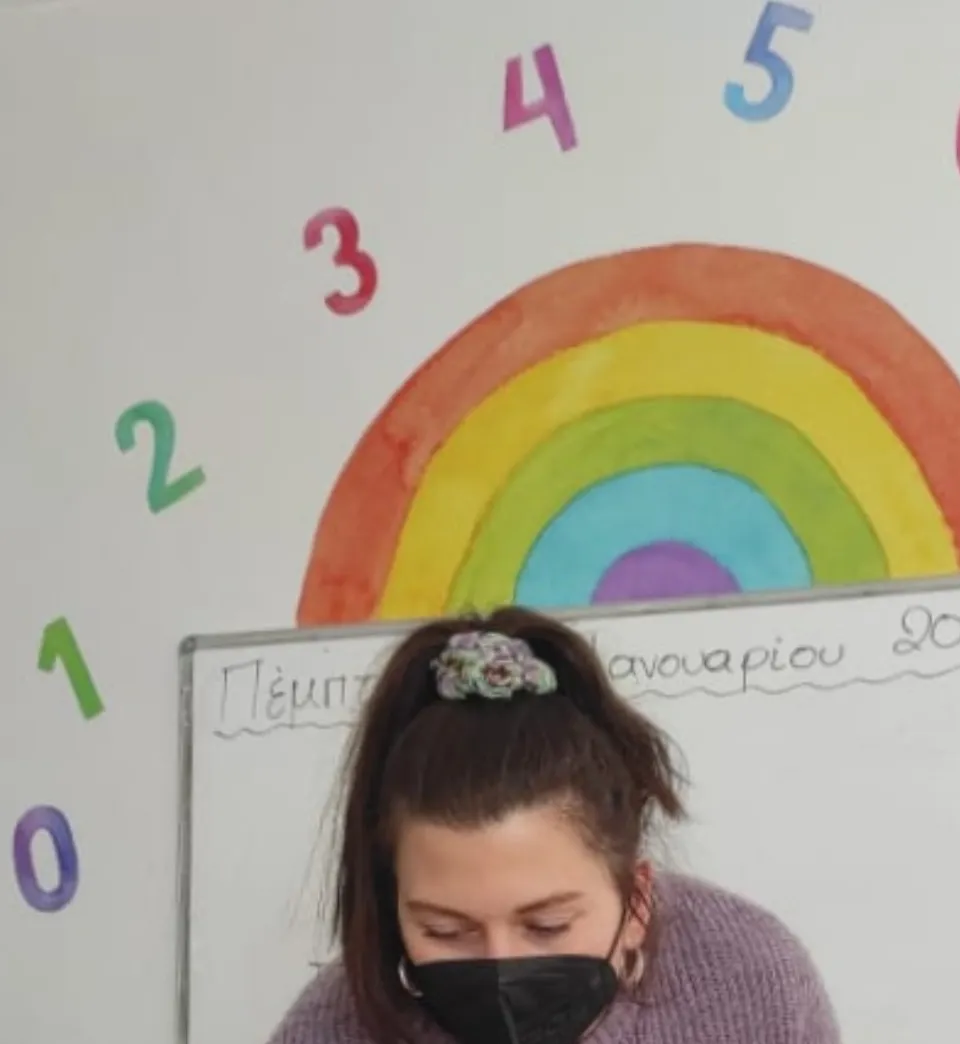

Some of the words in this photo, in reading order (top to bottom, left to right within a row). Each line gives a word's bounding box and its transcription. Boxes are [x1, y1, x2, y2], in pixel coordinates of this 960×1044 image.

[503, 44, 576, 151] 4
[725, 3, 804, 121] 5
[304, 208, 377, 315] 3
[117, 402, 204, 513] 2
[39, 618, 103, 719] 1
[220, 659, 378, 729] Πέμπτ
[13, 806, 78, 912] 0
